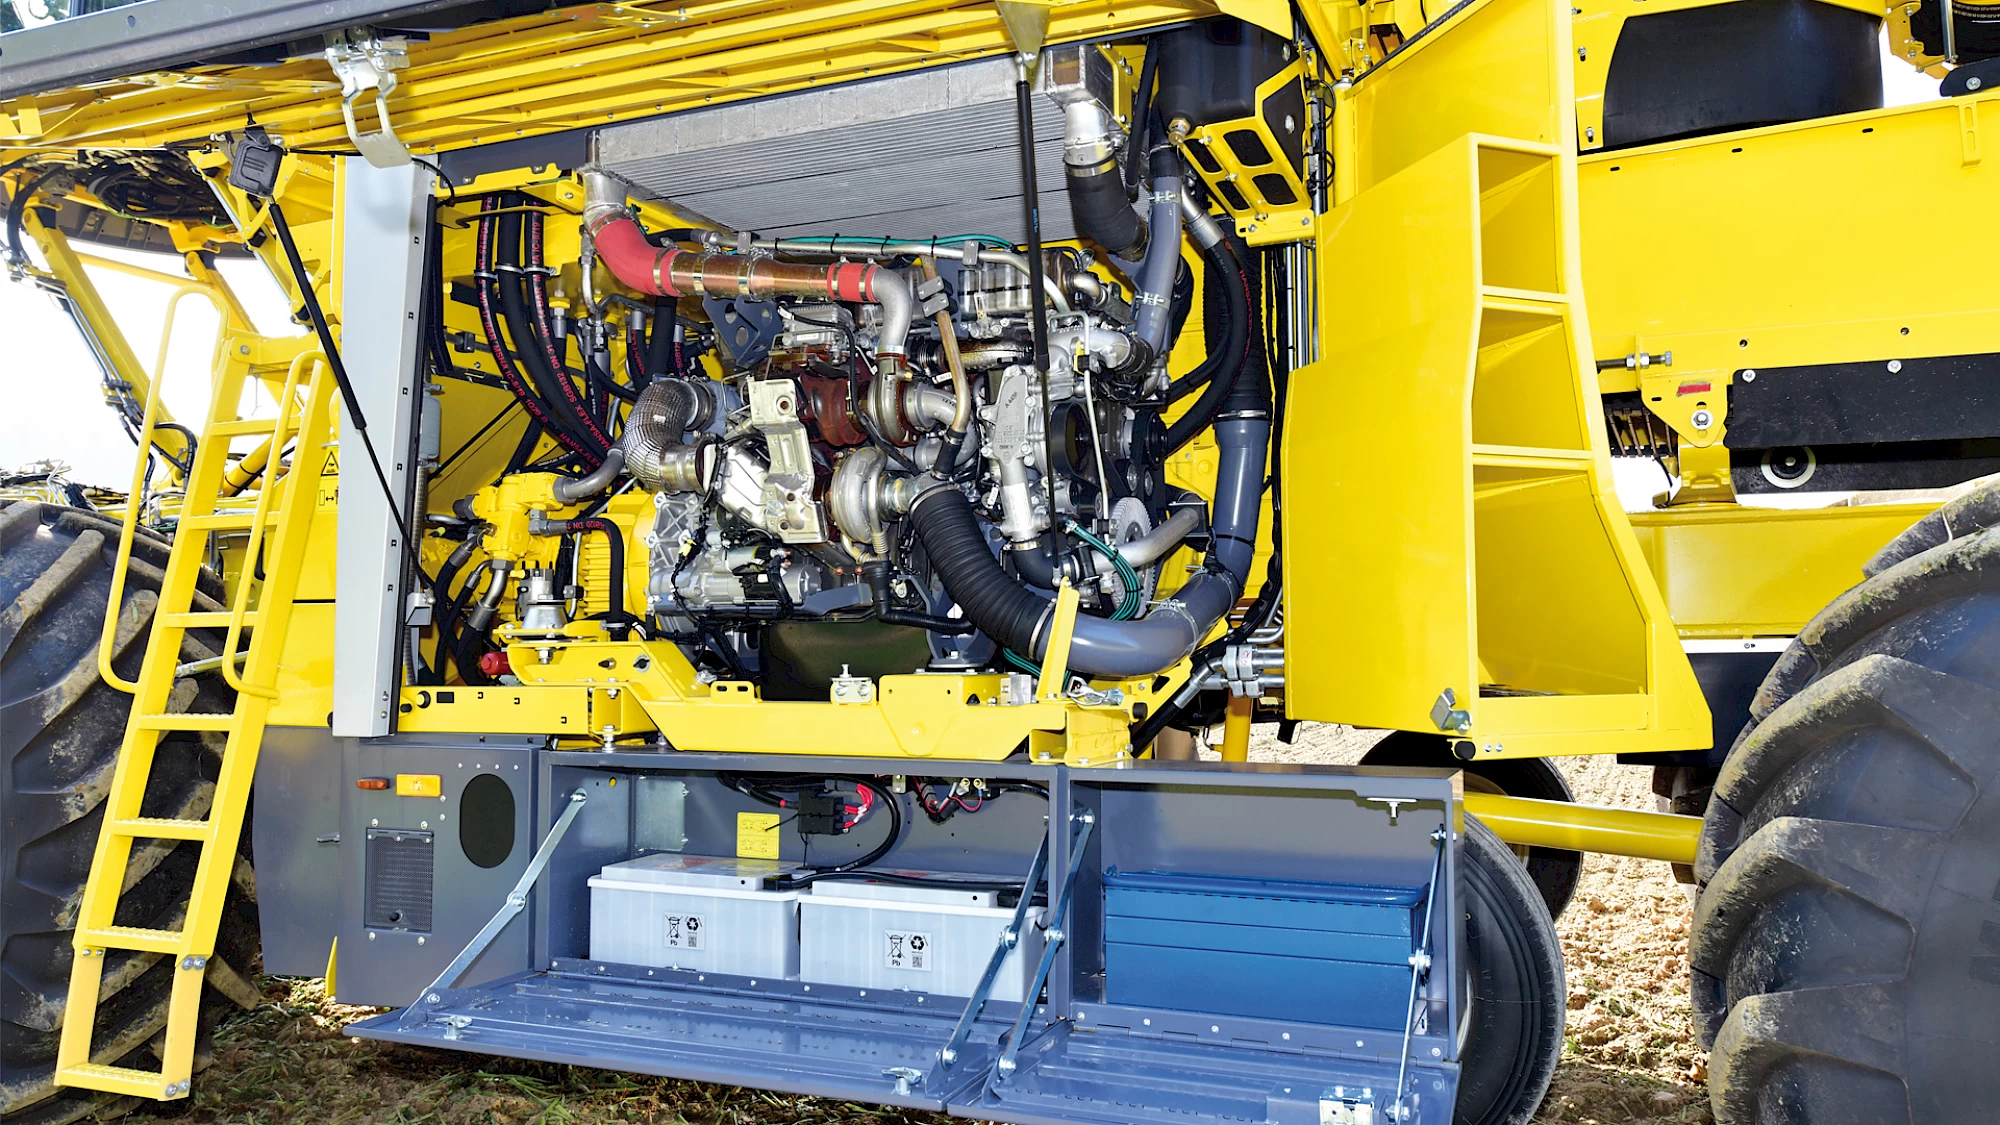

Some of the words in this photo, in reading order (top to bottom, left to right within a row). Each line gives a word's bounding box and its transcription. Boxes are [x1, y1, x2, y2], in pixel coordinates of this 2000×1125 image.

[479, 221, 489, 255] SGB125
[532, 221, 541, 253] IC-8/19
[479, 292, 489, 307] WP
[535, 286, 545, 307] BAR
[484, 321, 497, 341] BAR
[540, 322, 550, 338] WP
[492, 344, 508, 370] MSHA
[546, 344, 555, 354] 31
[550, 355, 561, 369] DN
[505, 370, 526, 397] IC-8/19
[556, 372, 578, 403] SGB132
[575, 404, 612, 450] HANSA-FLEX
[573, 521, 584, 530] DN
[891, 959, 901, 967] Pb
